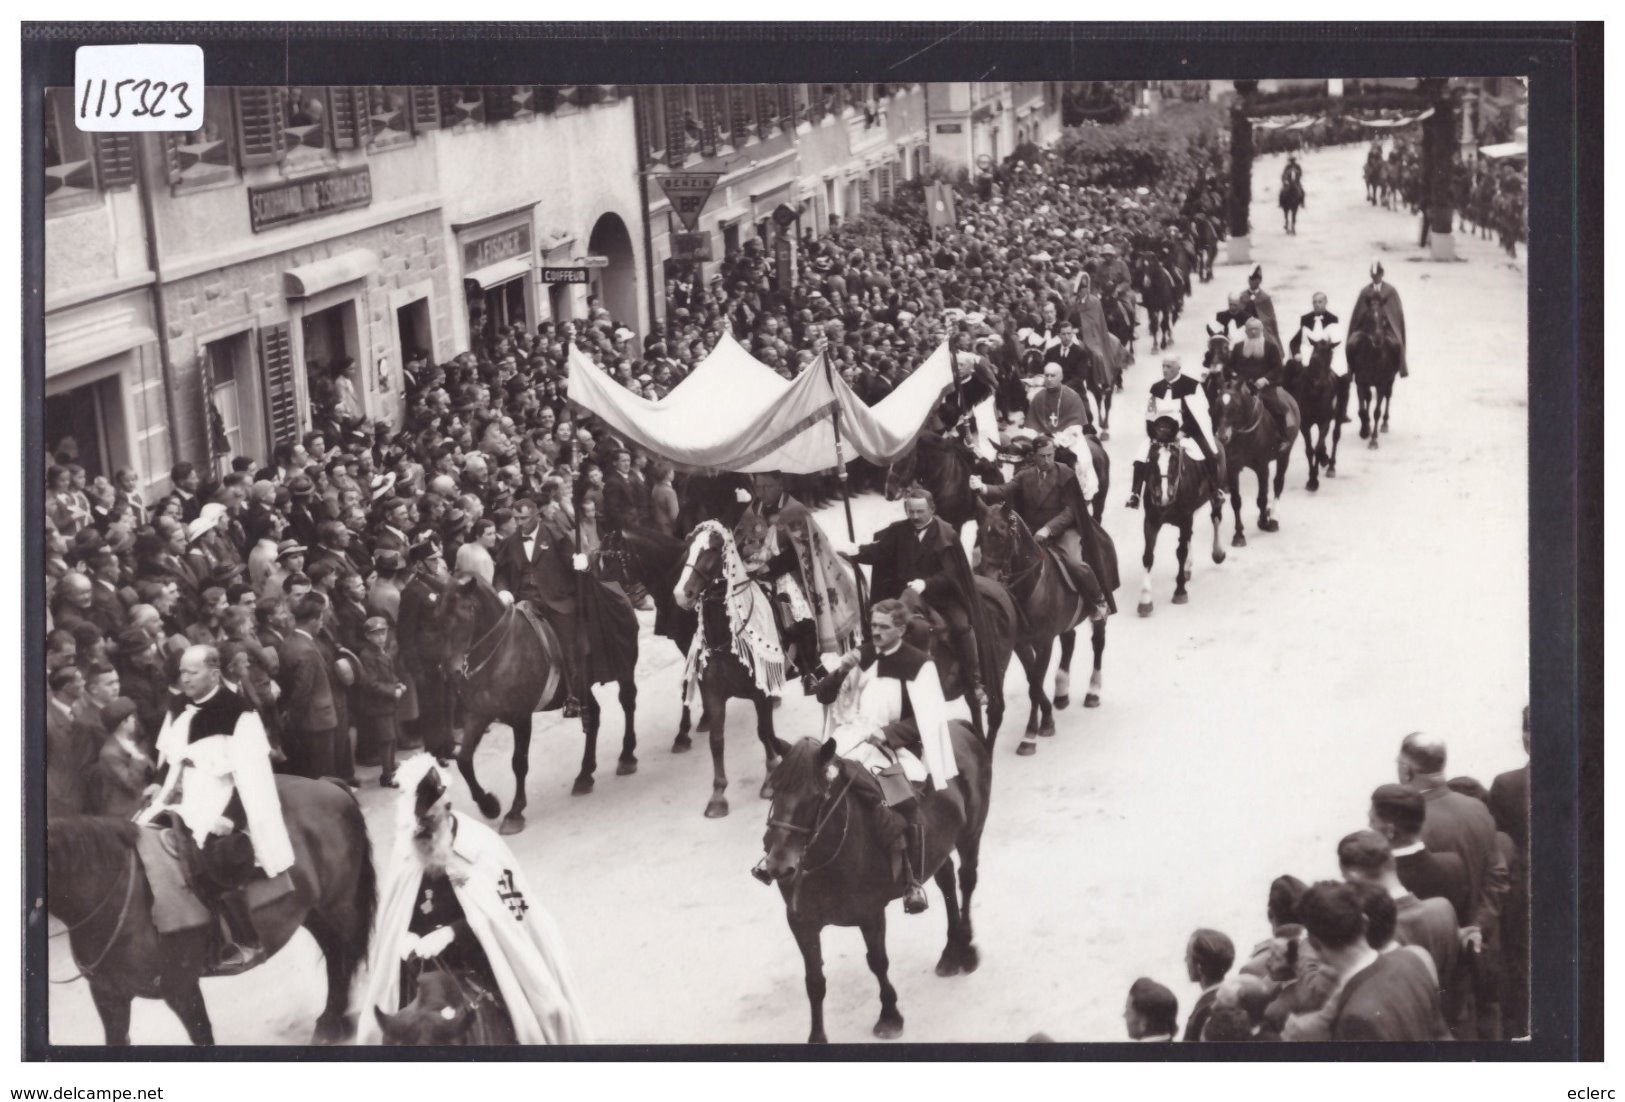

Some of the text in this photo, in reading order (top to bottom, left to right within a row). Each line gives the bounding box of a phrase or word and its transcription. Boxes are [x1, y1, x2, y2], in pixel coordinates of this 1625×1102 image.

[80, 79, 192, 118] 115323
[664, 179, 712, 188] BENZIN
[680, 195, 701, 213] BP
[545, 270, 586, 282] COIFFEUR
